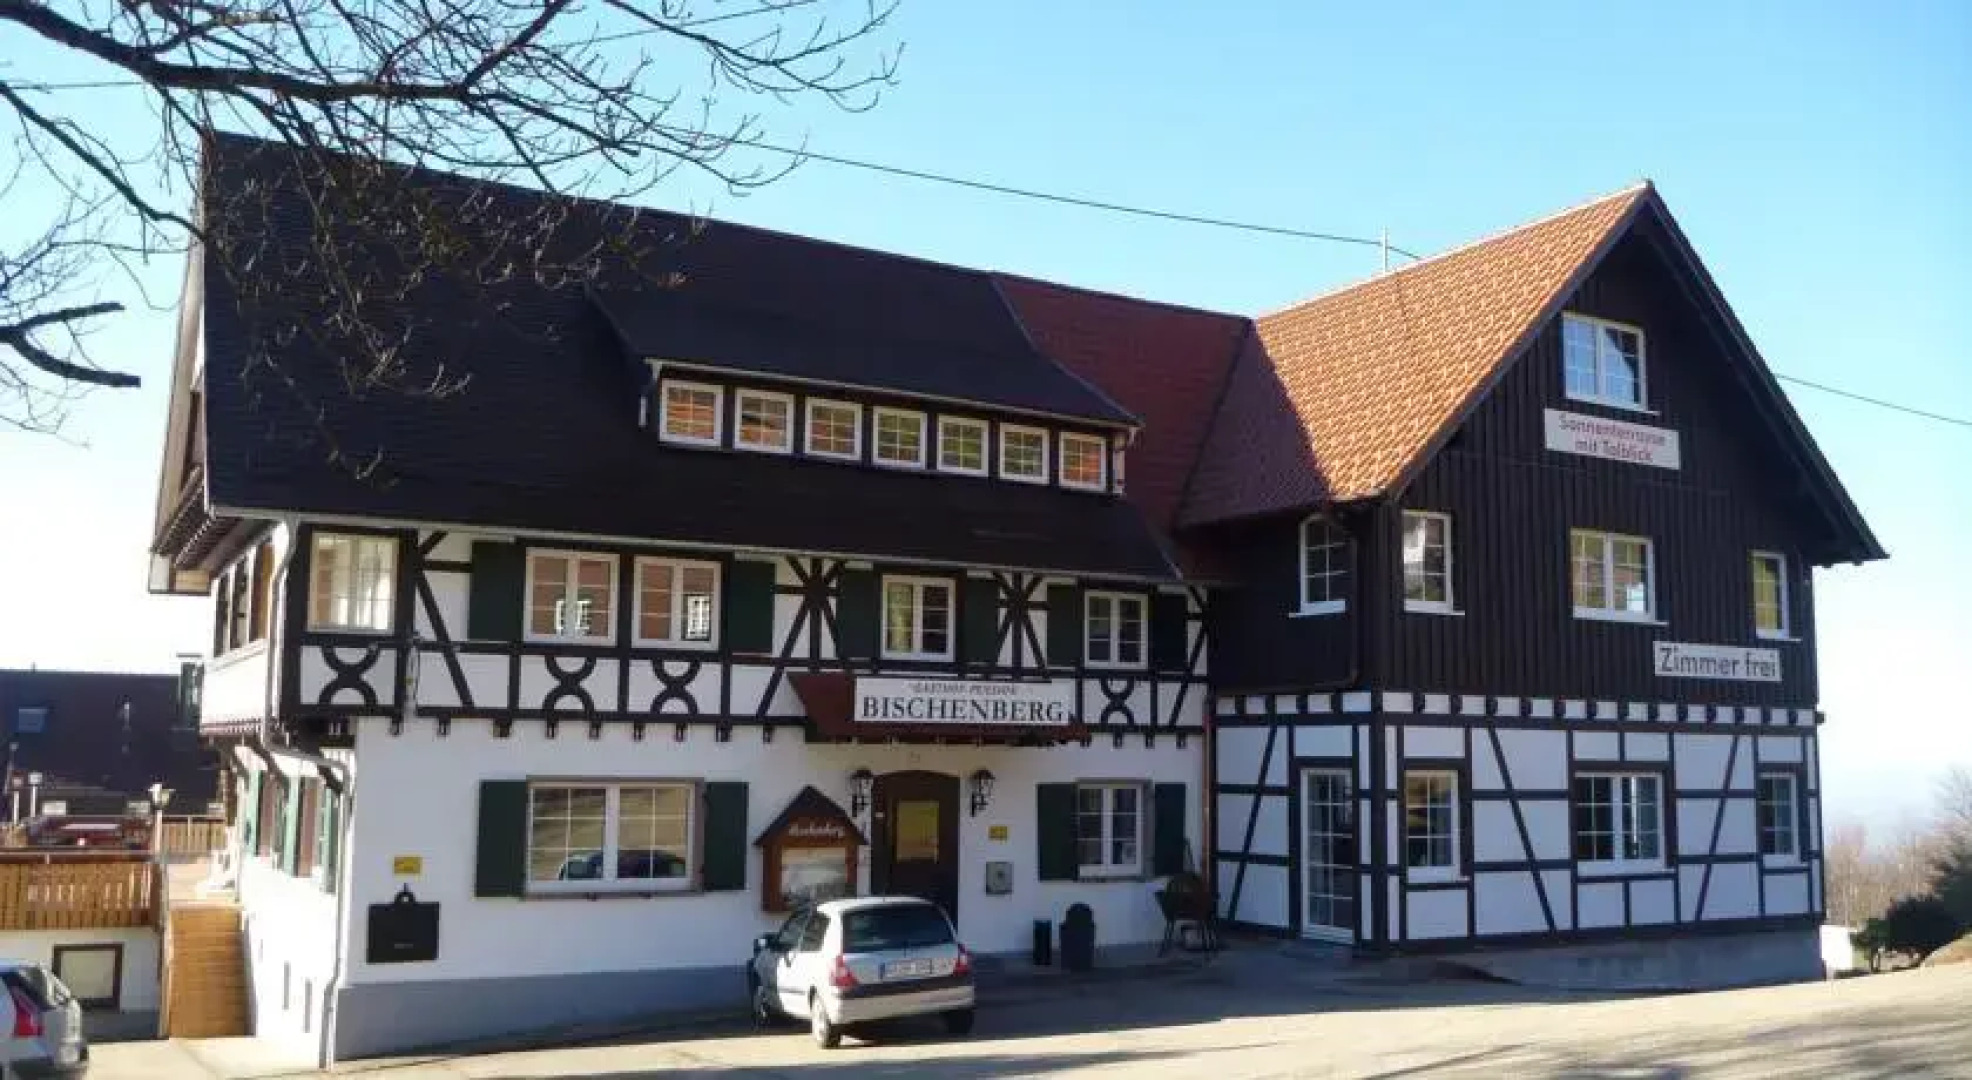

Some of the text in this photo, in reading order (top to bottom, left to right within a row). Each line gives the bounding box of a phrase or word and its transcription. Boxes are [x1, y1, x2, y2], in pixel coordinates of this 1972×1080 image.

[1575, 440, 1597, 453] mit
[1660, 645, 1777, 677] Zimmer frei
[862, 696, 1064, 721] BISCHENBERG
